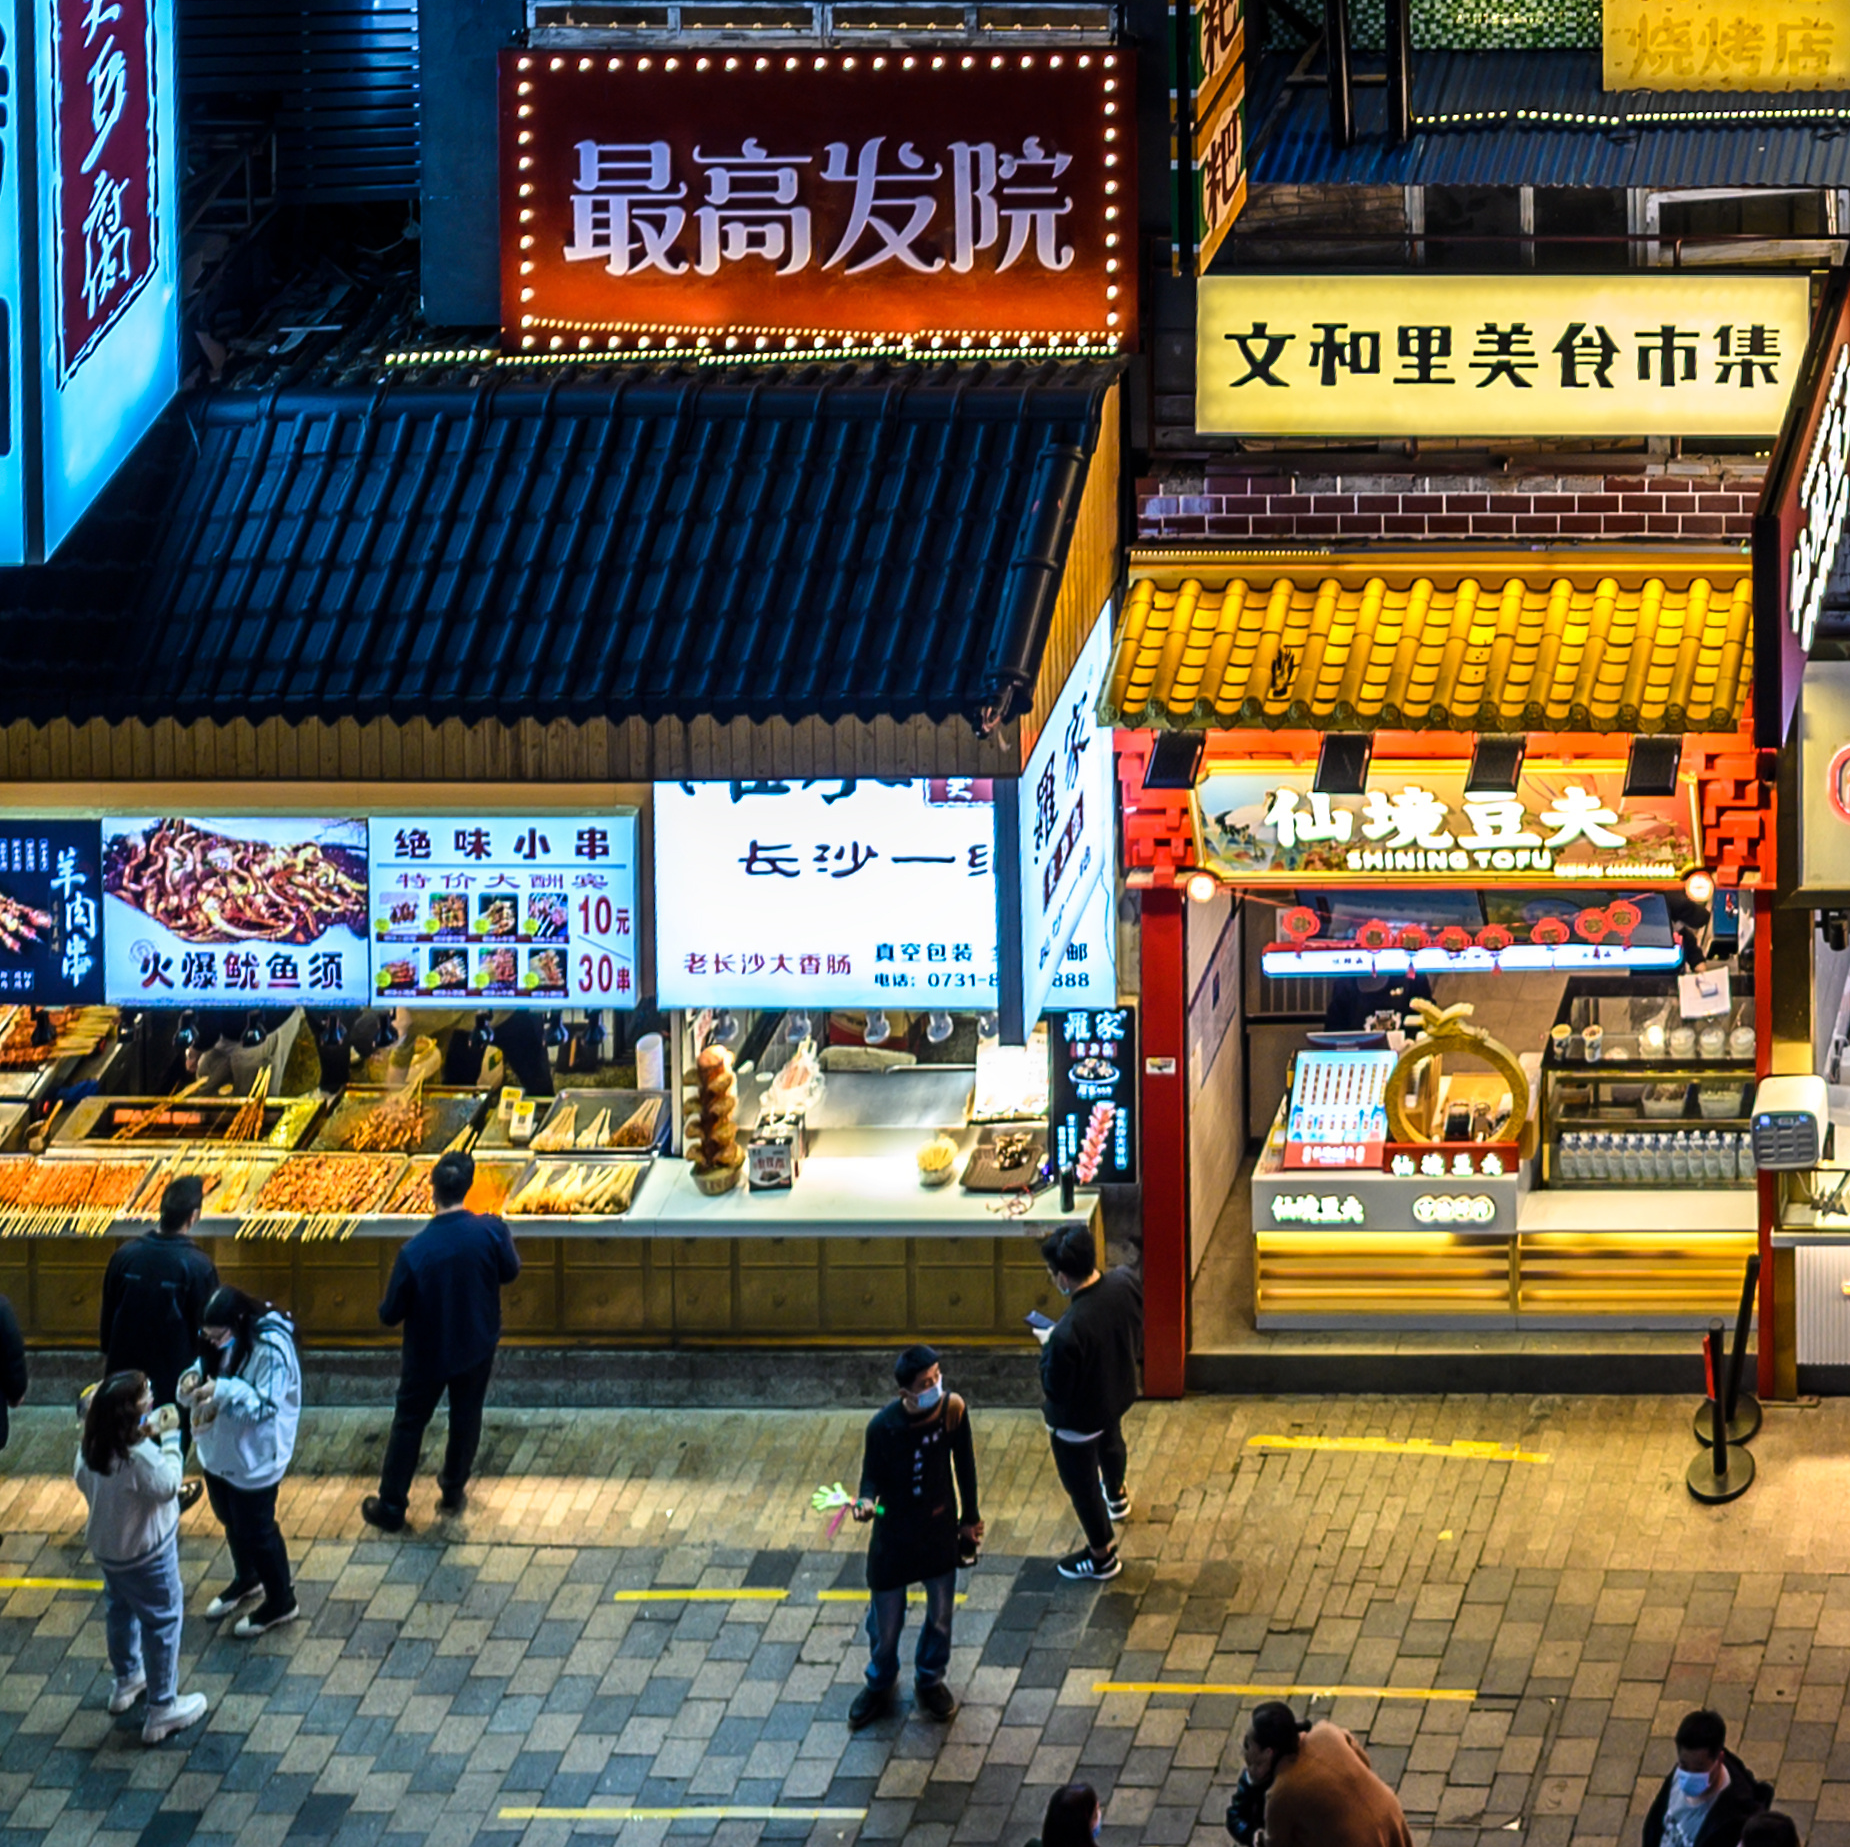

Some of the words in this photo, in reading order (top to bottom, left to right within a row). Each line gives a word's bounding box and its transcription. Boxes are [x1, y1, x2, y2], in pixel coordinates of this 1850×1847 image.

[1628, 17, 1833, 79] 烧烤店
[564, 136, 1075, 277] 最高发院
[1224, 322, 1781, 388] 文和里美食市集
[1265, 785, 1627, 850] 仙境豆夫
[395, 827, 611, 860] 绝味小串
[1347, 850, 1469, 870] SHINING
[1475, 850, 1552, 870] TOFU
[51, 847, 97, 986] 羊肉串
[578, 894, 631, 937] 10元
[139, 951, 344, 990] 火爆鱿鱼须
[578, 952, 632, 994] 30串
[683, 952, 852, 977] 老长沙大香肠
[875, 943, 974, 964] 真空包装
